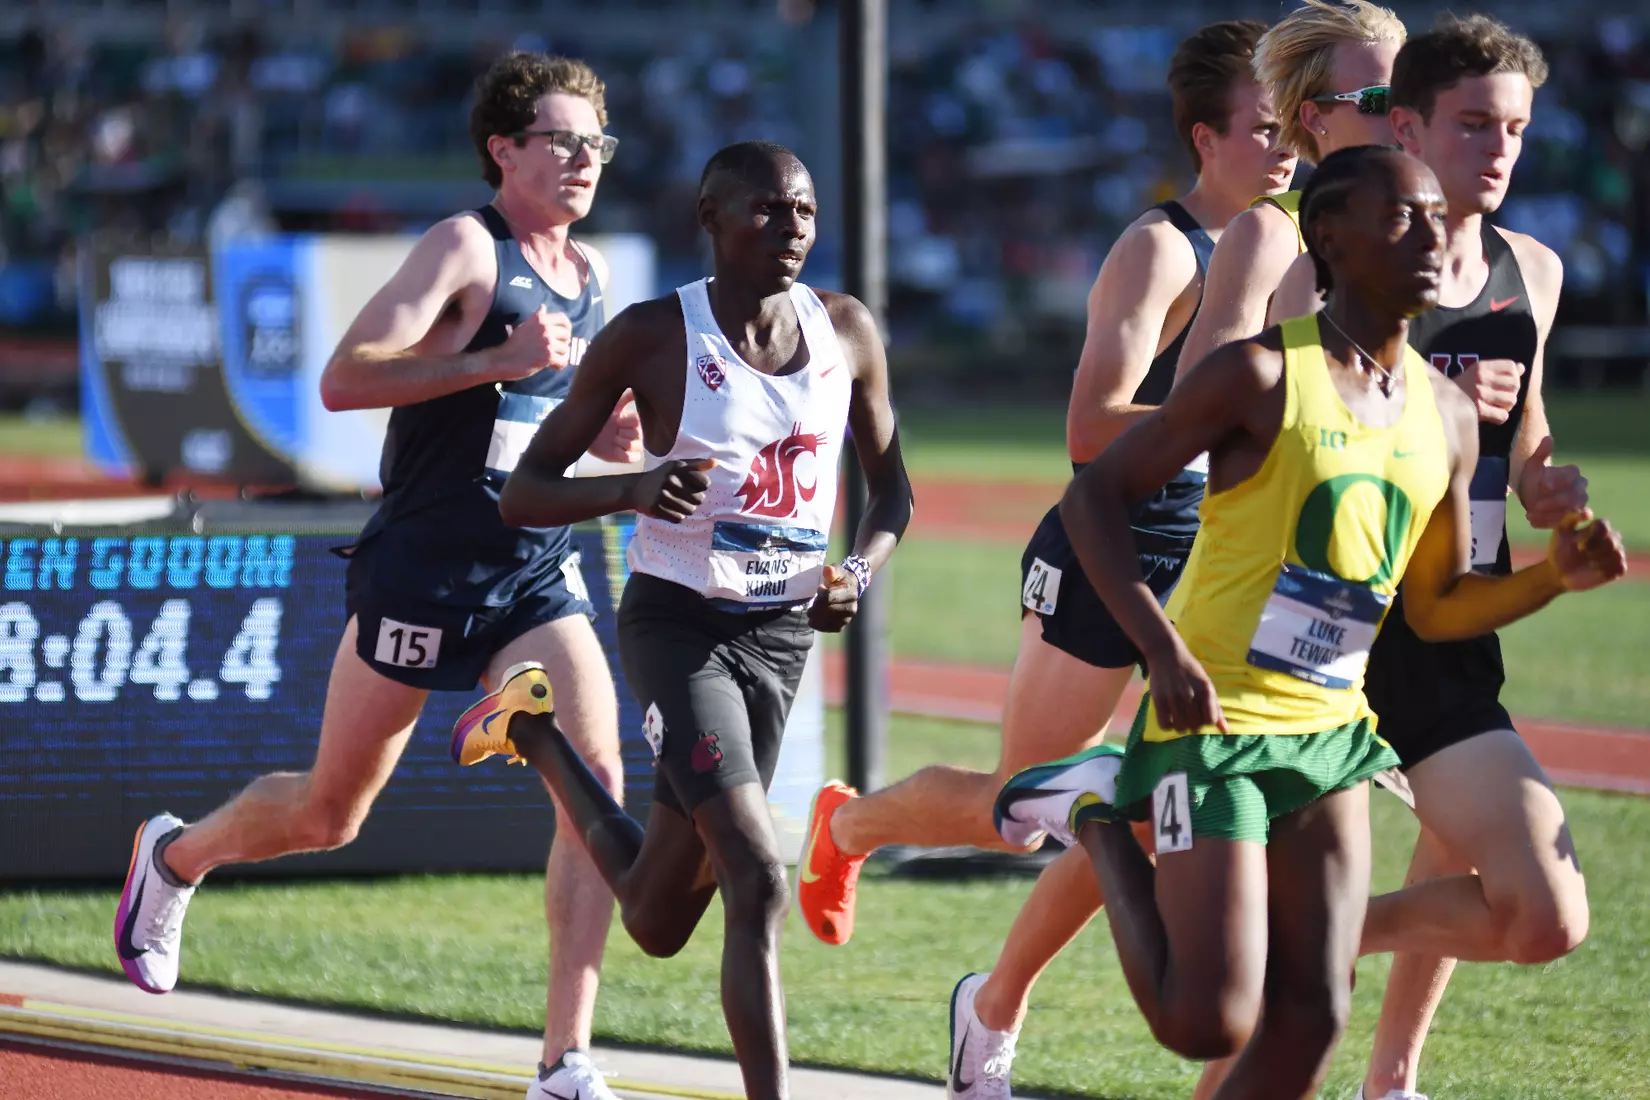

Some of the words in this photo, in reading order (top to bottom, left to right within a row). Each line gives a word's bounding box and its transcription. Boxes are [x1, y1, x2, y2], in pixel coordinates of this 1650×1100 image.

[0, 538, 79, 590] EN
[745, 560, 790, 576] EVANS
[389, 628, 429, 667] 15
[1308, 618, 1347, 646] LUKE
[1290, 636, 1345, 665] TEWA
[1160, 784, 1182, 848] 4
